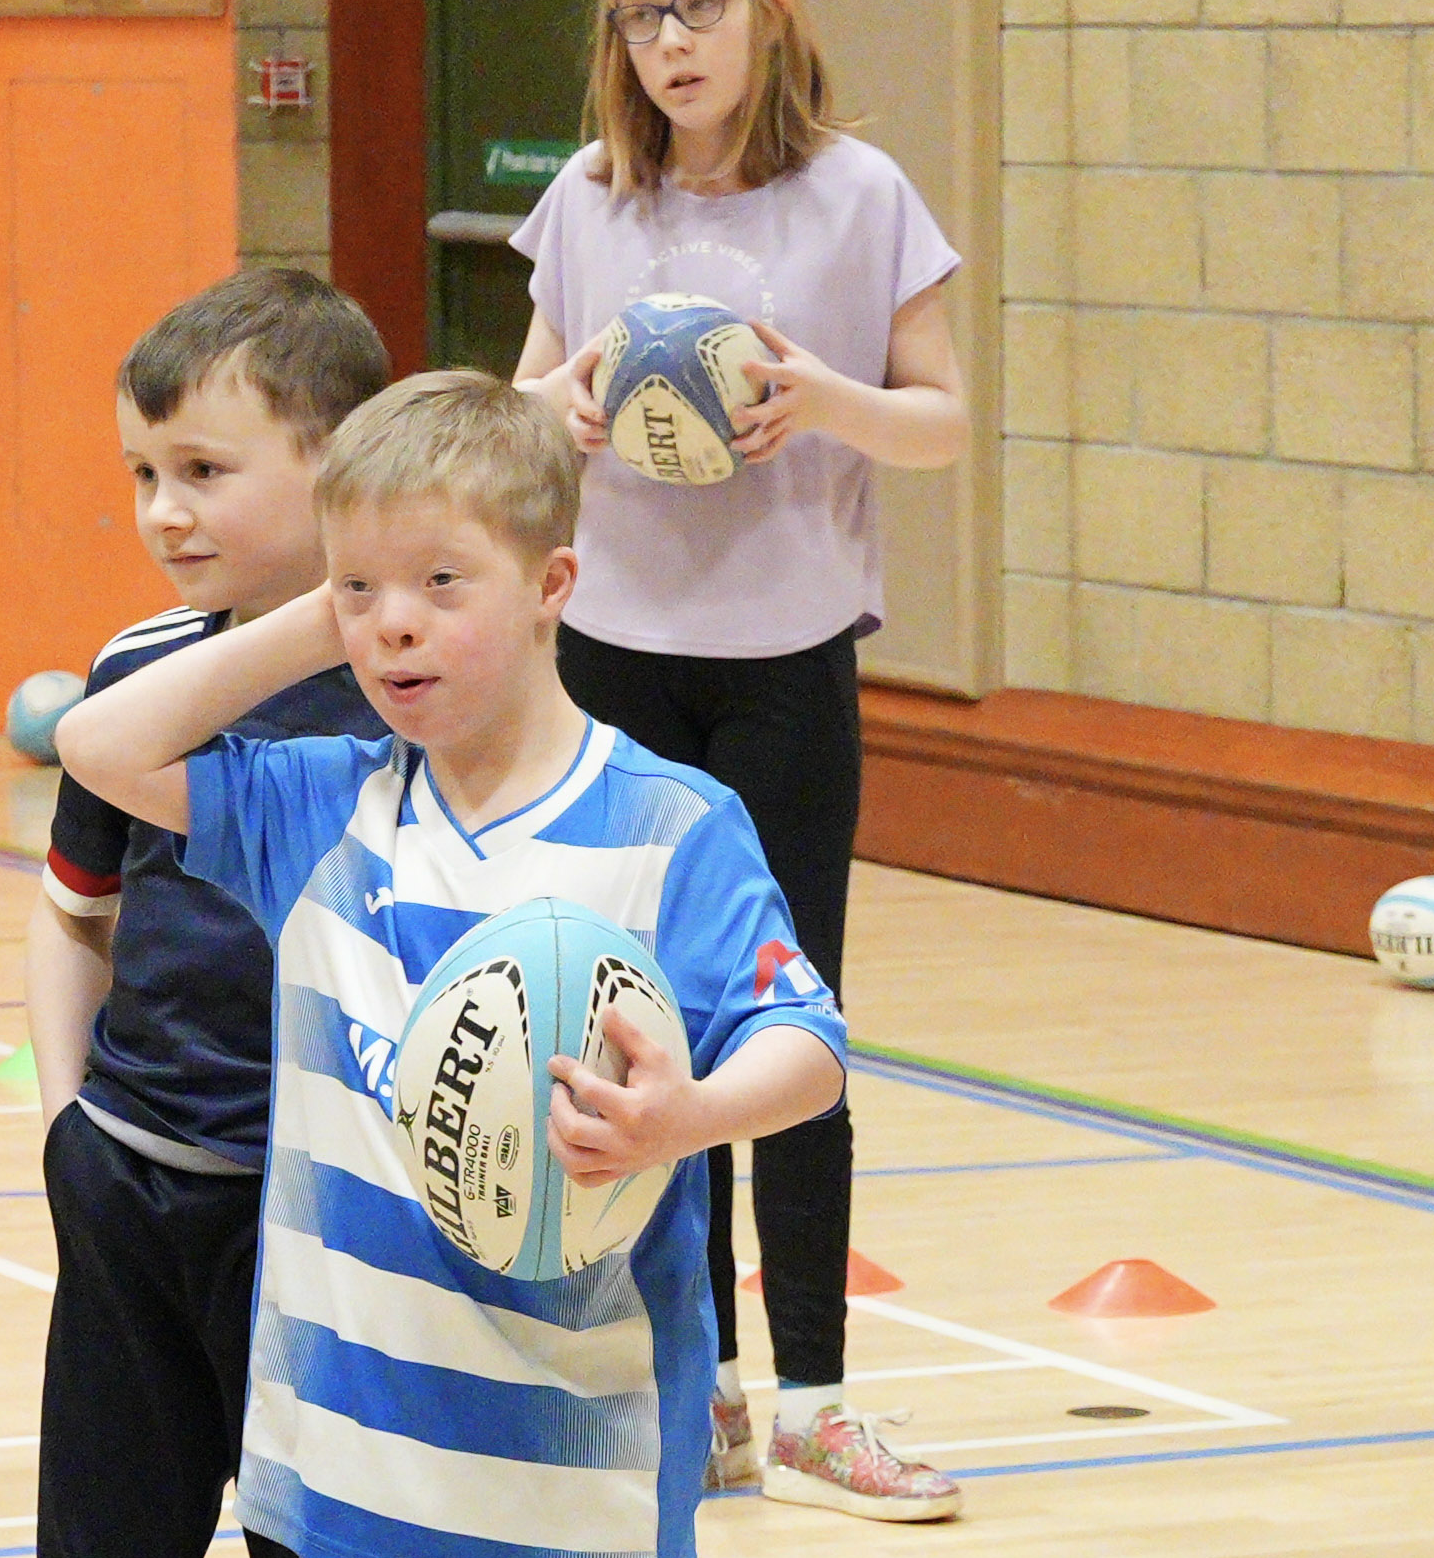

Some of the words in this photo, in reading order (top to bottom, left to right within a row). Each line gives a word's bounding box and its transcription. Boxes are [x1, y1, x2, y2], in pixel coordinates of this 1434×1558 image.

[463, 1123, 481, 1201] G-TR4000
[480, 1134, 492, 1160] BALL
[477, 1160, 488, 1202] TRAINER
